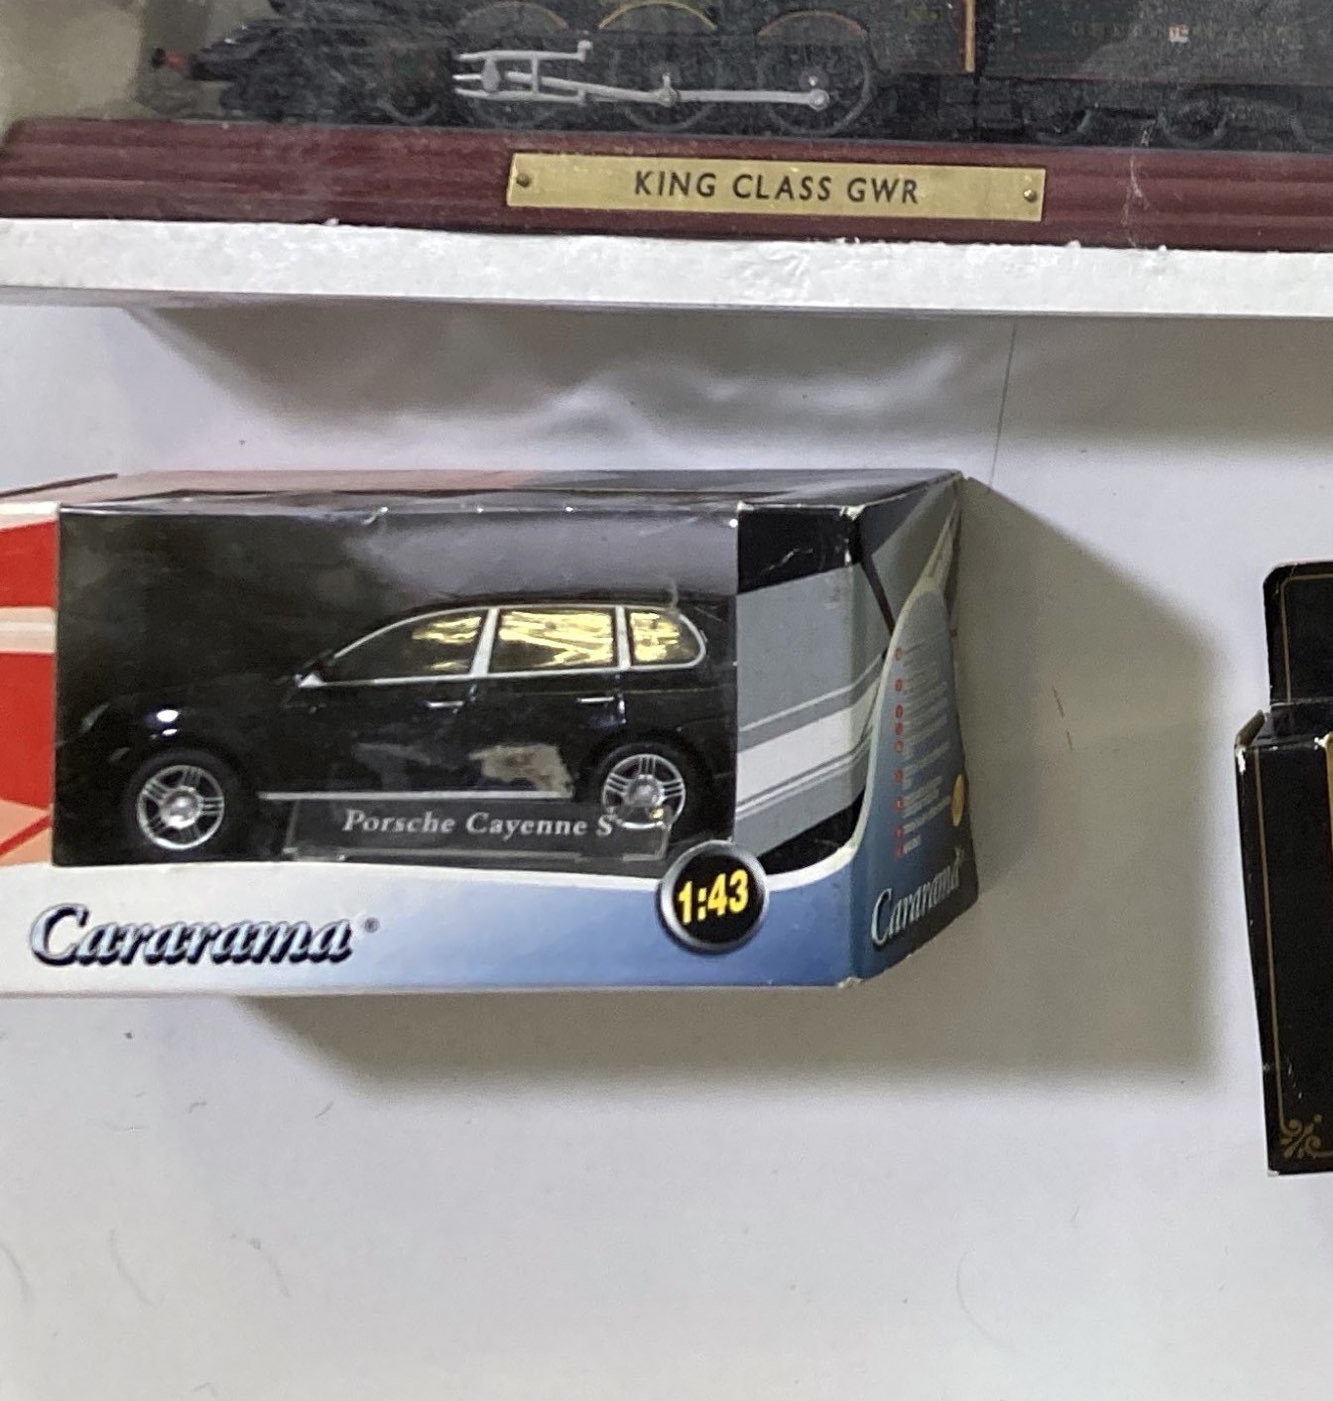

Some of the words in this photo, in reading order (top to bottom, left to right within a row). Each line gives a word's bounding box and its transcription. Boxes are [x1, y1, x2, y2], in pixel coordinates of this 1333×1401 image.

[635, 170, 717, 198] KING
[732, 173, 832, 201] CLASS
[847, 177, 919, 204] GWR
[343, 808, 456, 833] Porsche
[465, 810, 588, 842] Cayenne
[596, 813, 613, 838] S
[677, 868, 749, 926] 1:43
[29, 902, 354, 966] Cararama
